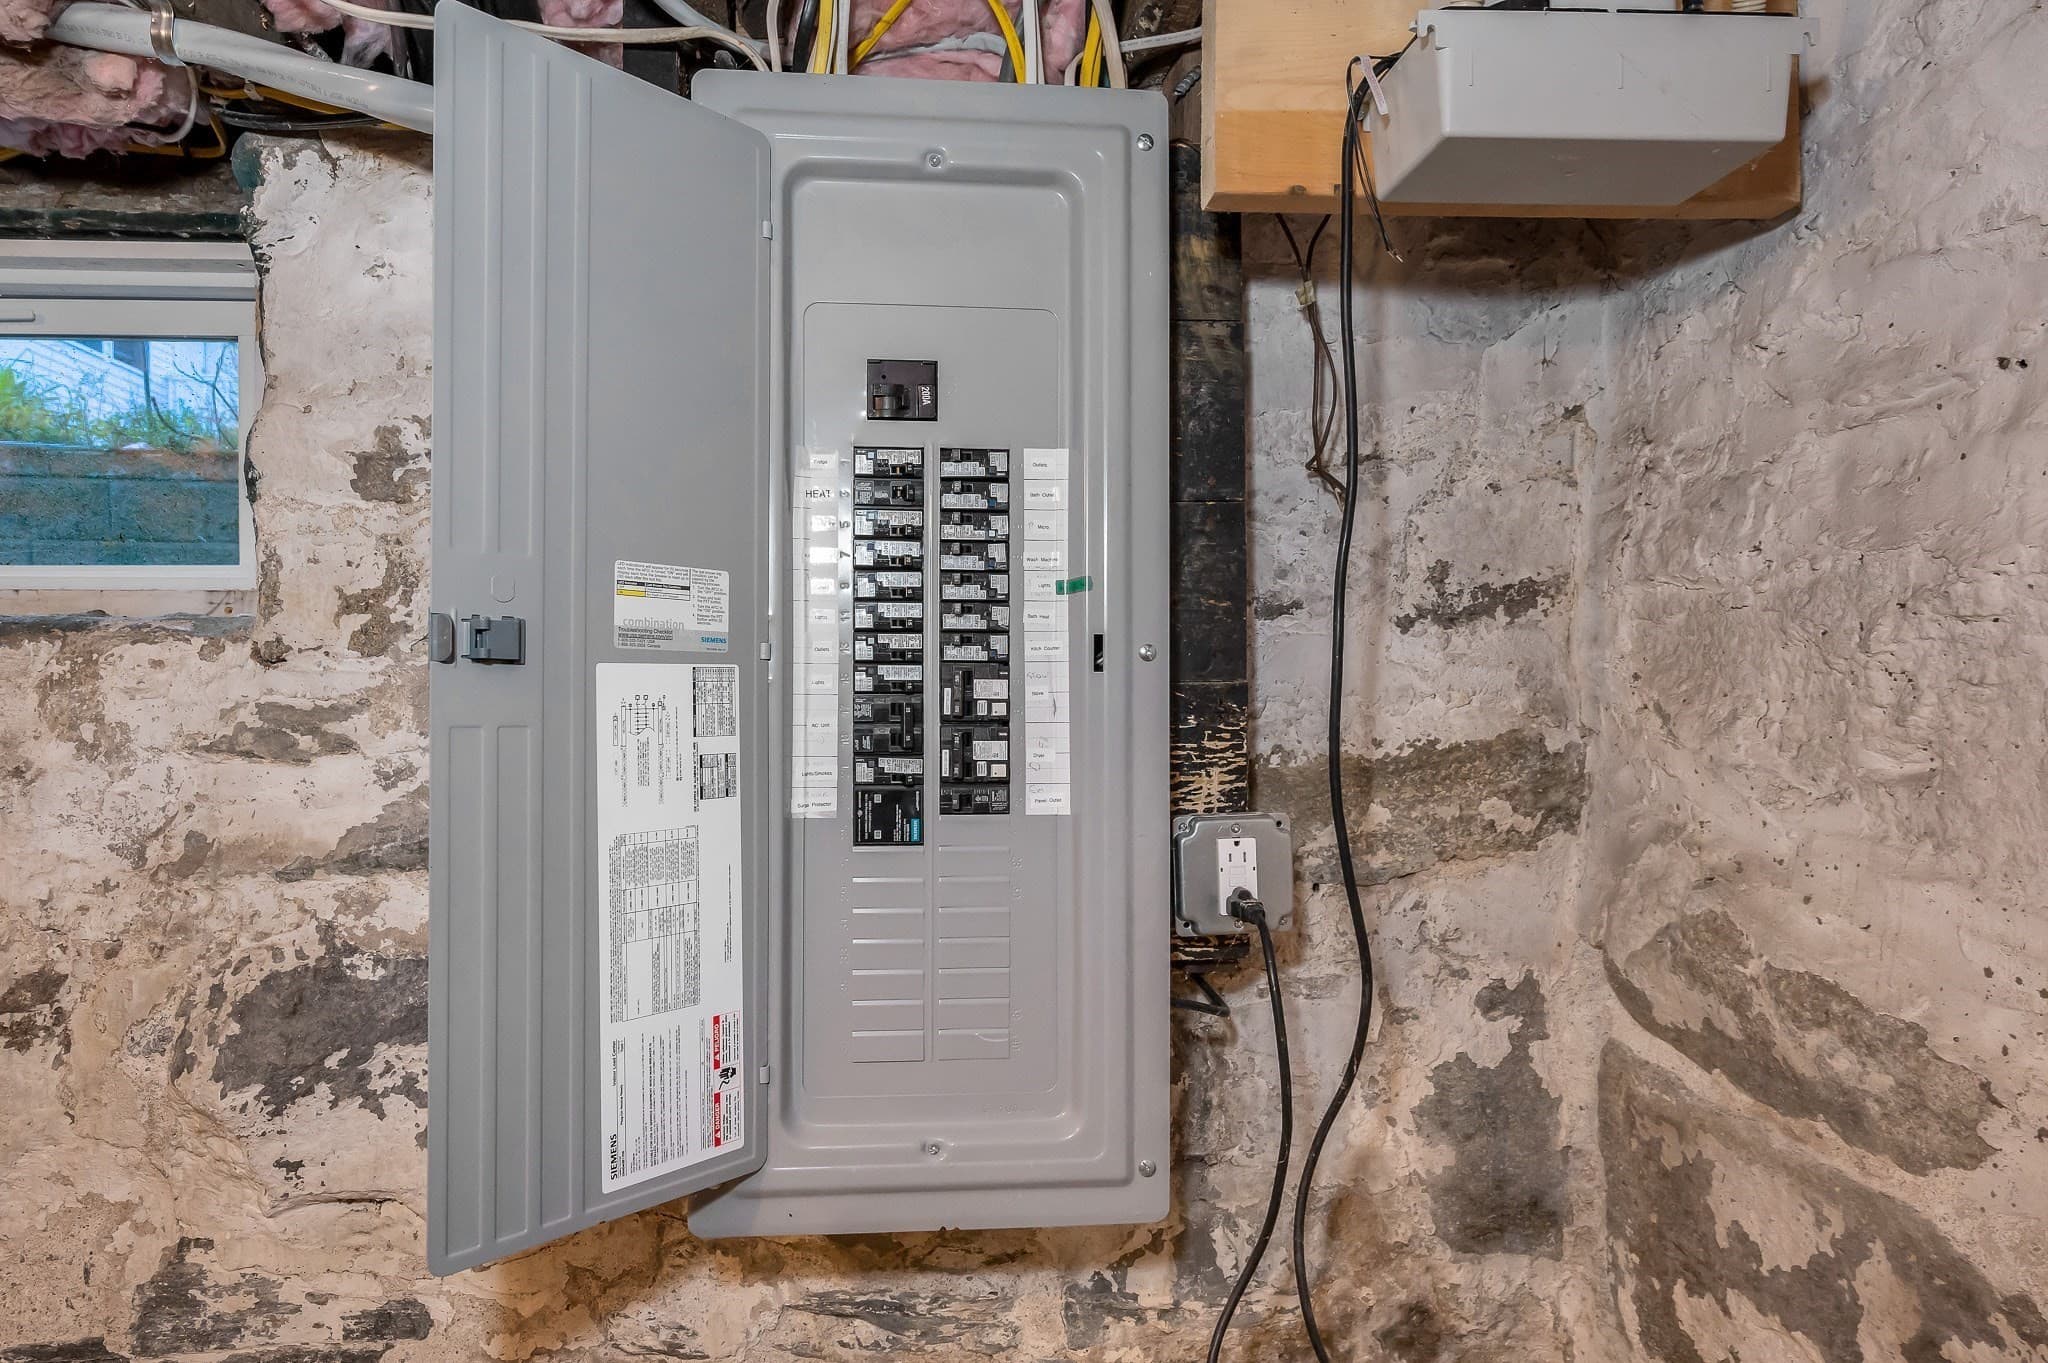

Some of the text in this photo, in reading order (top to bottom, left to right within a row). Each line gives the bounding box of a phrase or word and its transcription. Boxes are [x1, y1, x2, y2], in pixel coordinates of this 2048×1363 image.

[921, 386, 931, 405] 200A
[805, 489, 831, 498] HEAT
[839, 520, 850, 529] 5
[839, 551, 850, 559] 7
[839, 582, 850, 590] 9
[623, 616, 685, 631] combination
[700, 636, 727, 644] SIEMENS
[610, 1133, 618, 1180] SIEMENS
